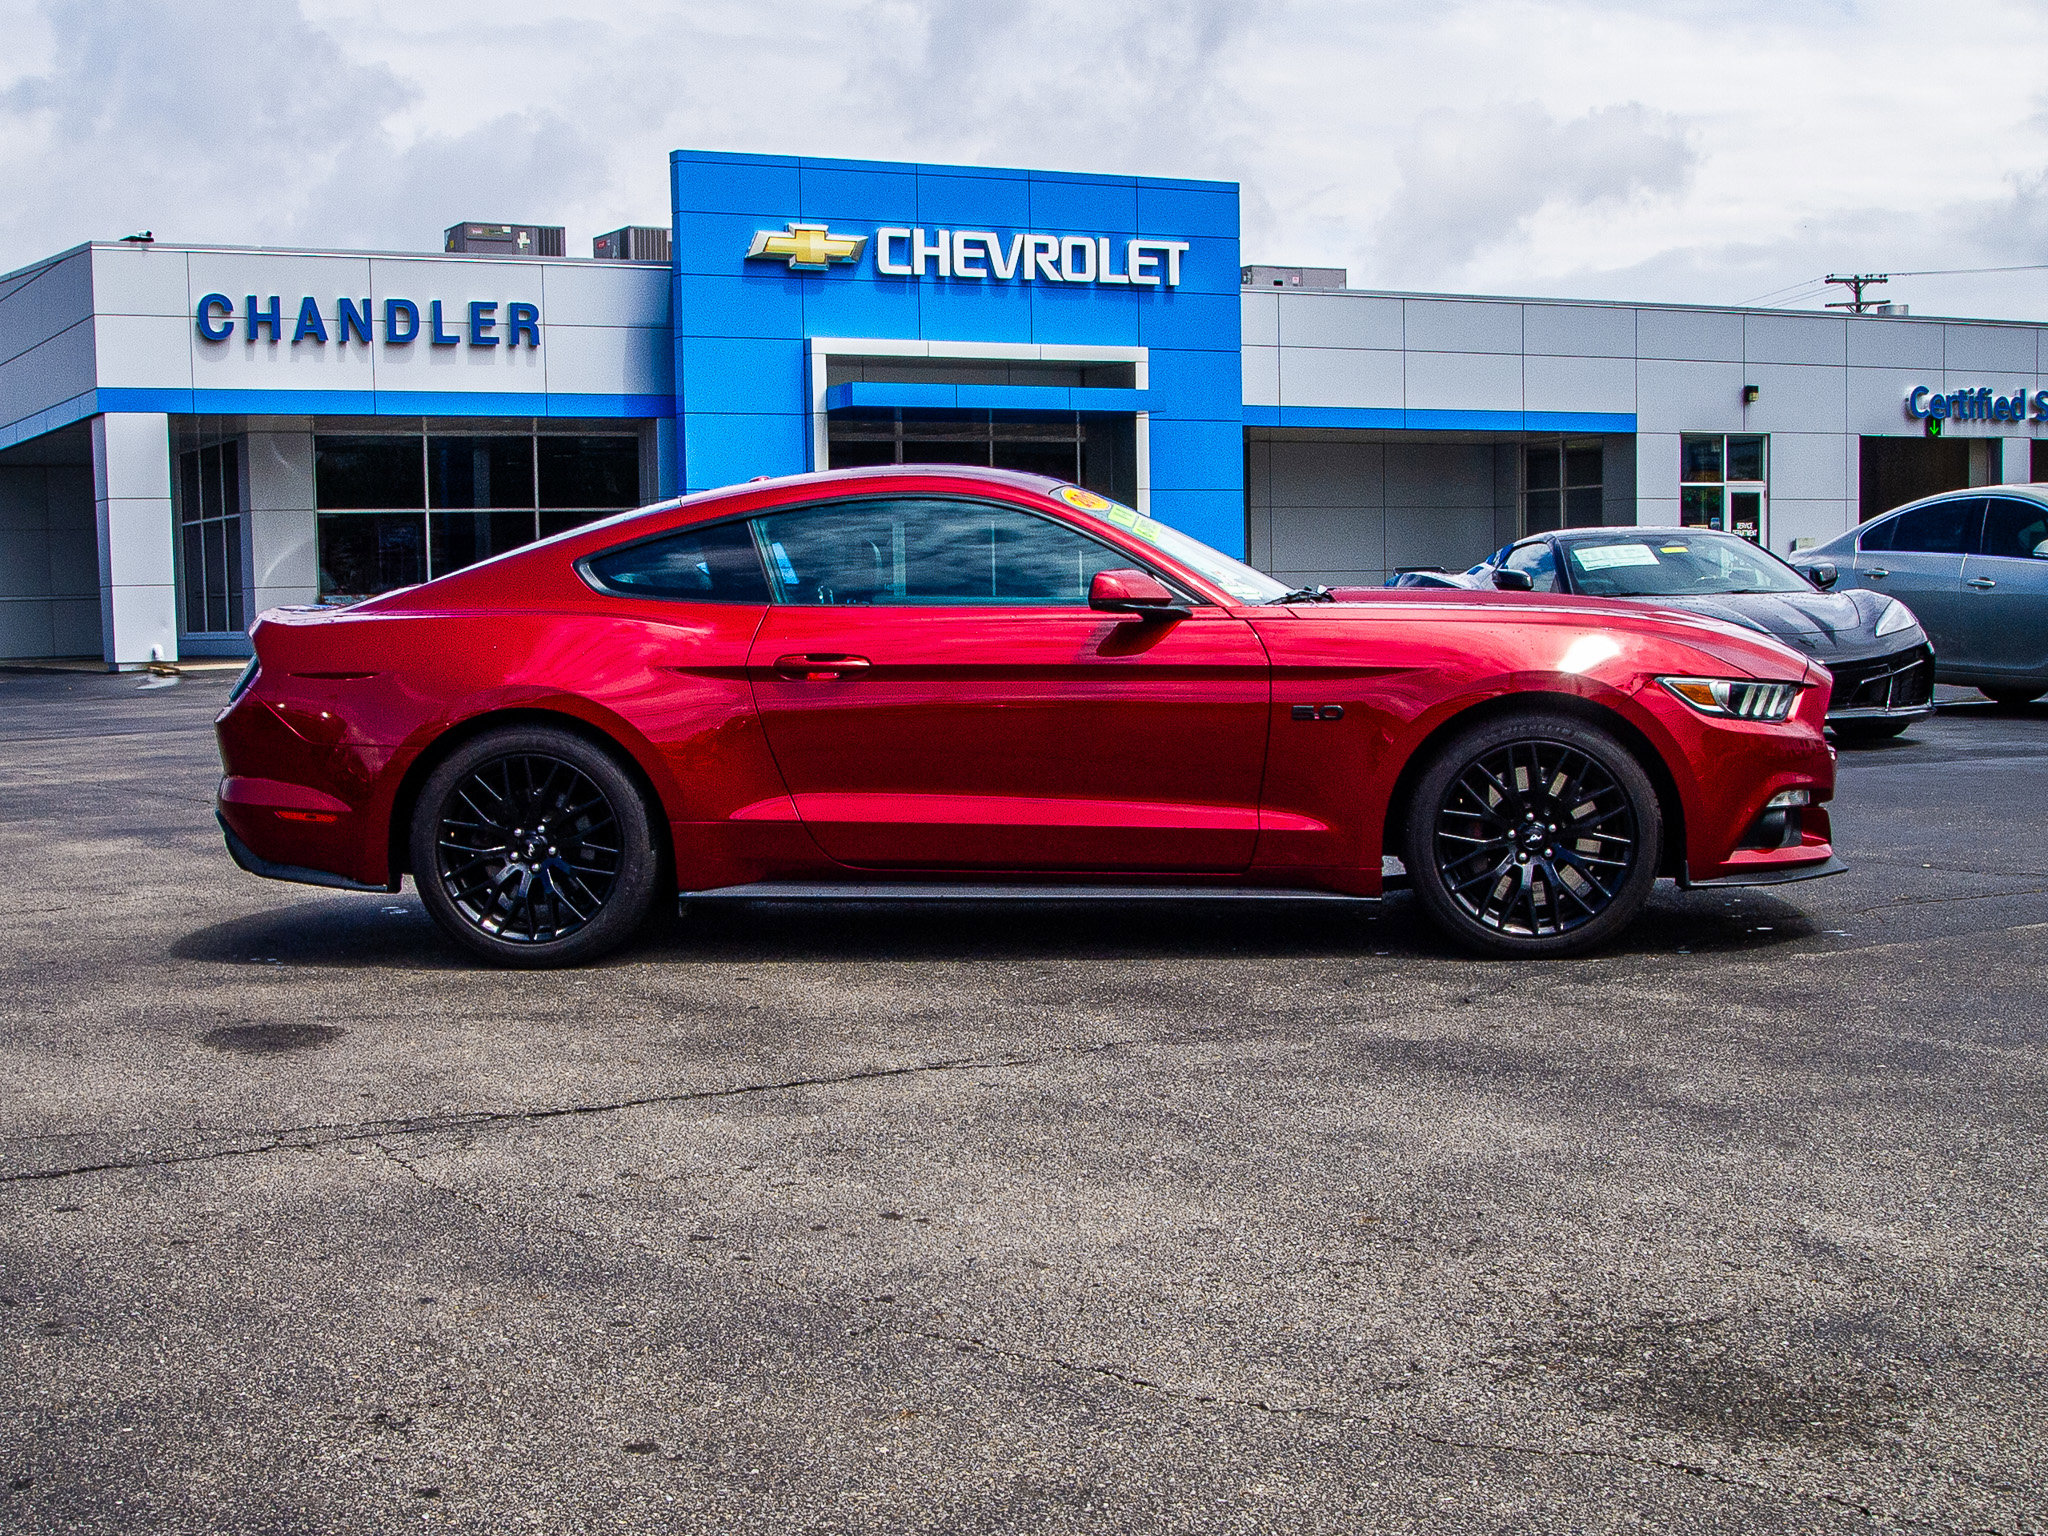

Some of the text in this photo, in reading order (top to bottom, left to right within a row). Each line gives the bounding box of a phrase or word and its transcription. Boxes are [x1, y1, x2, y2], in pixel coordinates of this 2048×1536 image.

[876, 226, 1189, 287] CHEVROLET
[197, 292, 540, 347] CHANDLER
[1907, 385, 2027, 421] Certified
[1291, 704, 1345, 720] 5.0
